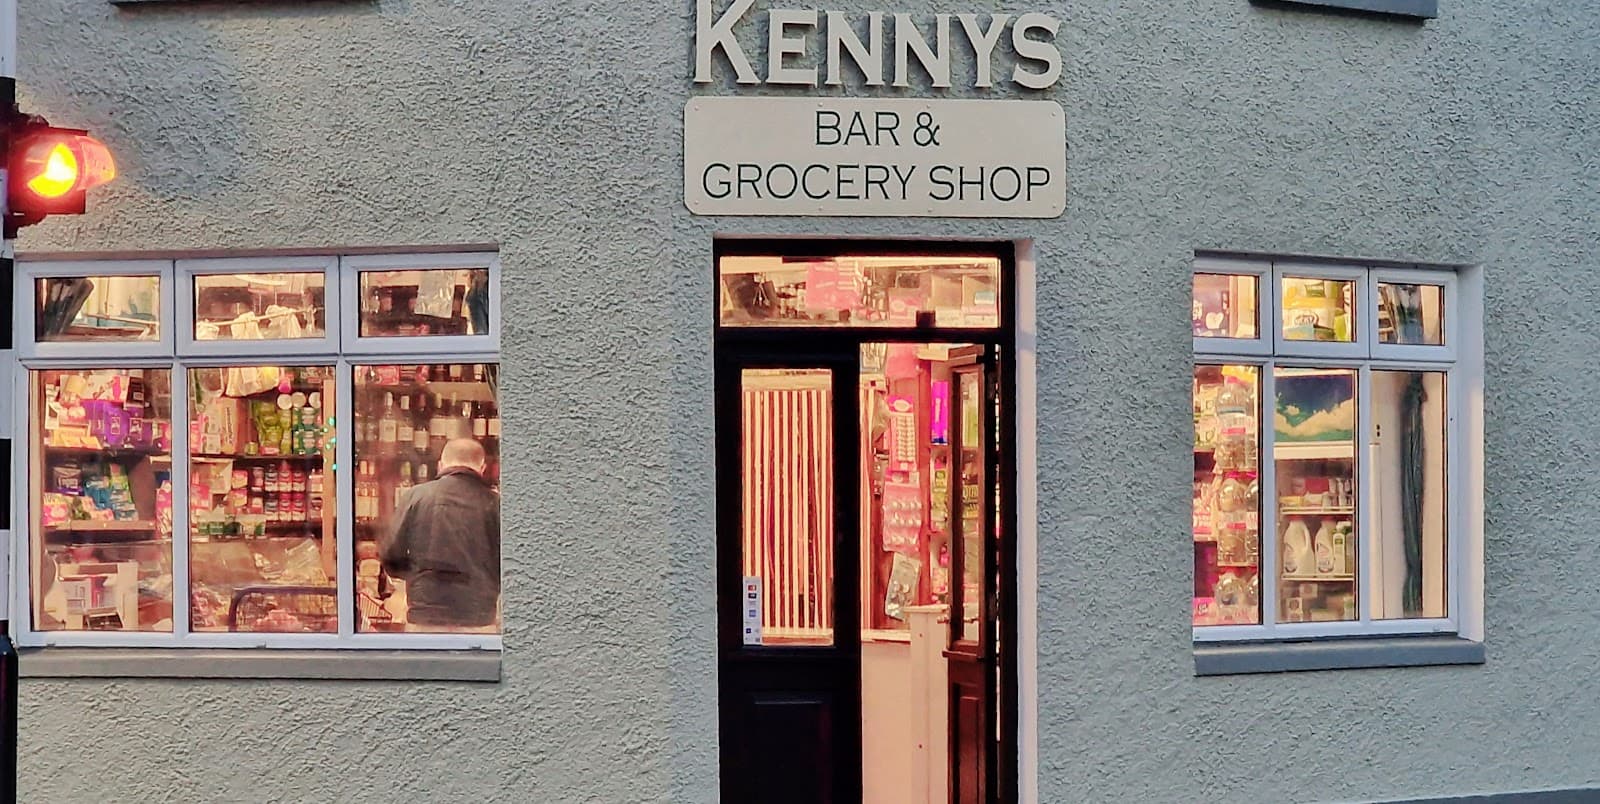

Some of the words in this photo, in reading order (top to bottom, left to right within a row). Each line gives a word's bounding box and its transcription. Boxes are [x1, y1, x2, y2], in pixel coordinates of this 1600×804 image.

[693, 0, 1063, 89] KENNYS
[815, 110, 902, 147] BAR
[912, 111, 940, 147] &
[702, 162, 916, 200] GROCERY
[928, 165, 1051, 202] SHOP
